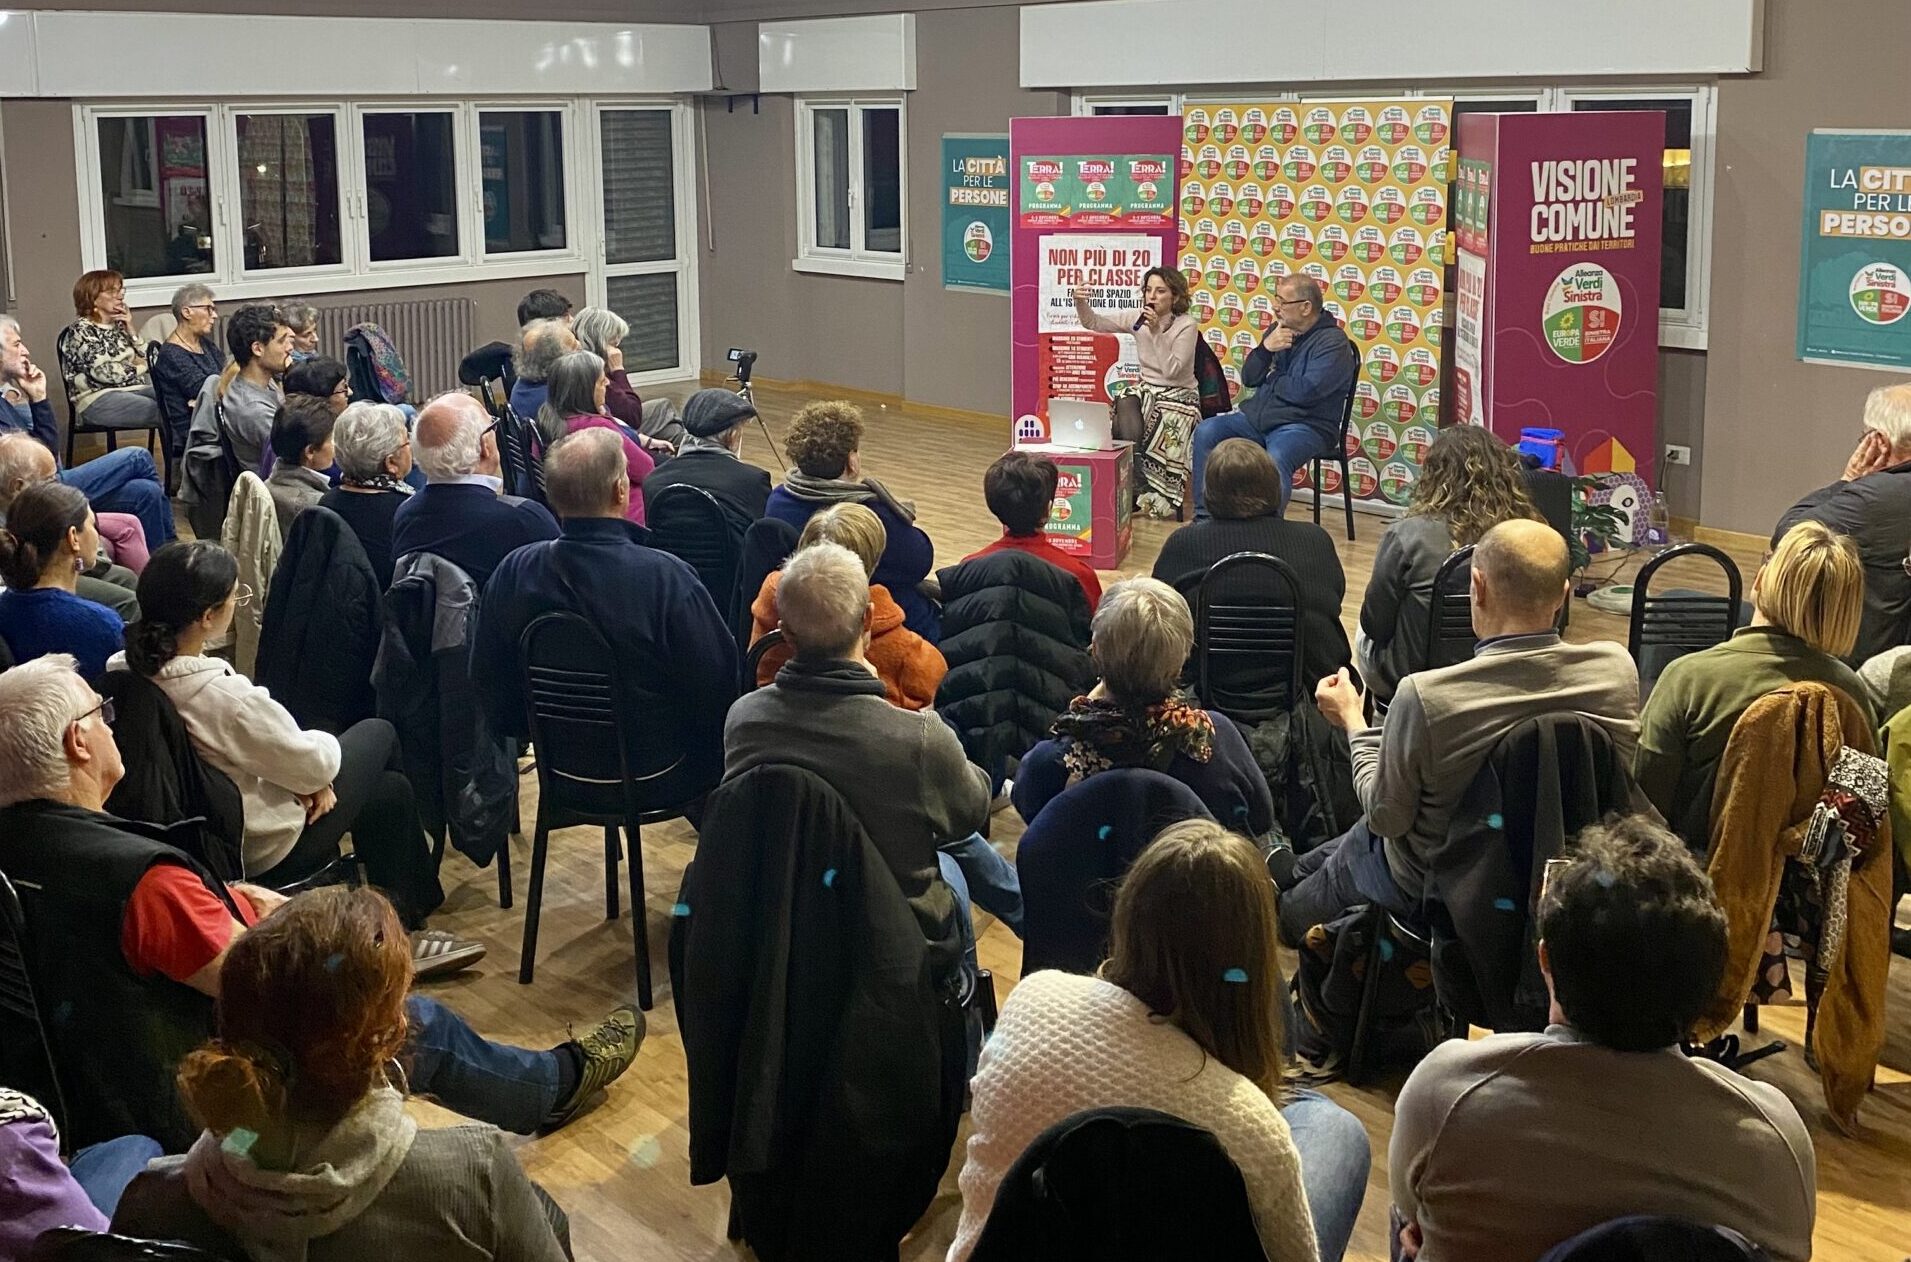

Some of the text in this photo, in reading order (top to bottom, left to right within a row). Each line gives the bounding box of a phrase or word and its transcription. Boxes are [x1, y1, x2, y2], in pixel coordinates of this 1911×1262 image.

[952, 154, 1005, 174] LA CITTÀ
[963, 175, 993, 188] PER LE
[1531, 158, 1637, 202] VISIONE
[1830, 169, 1911, 190] LA CIT
[951, 190, 1007, 205] PERSONE
[1854, 192, 1891, 211] PER
[1530, 201, 1636, 242] COMUNE
[1530, 239, 1635, 254] BUONE PRATICHE DAI TERRITORI
[1048, 245, 1150, 268] NON PIÙ DI 20
[1057, 268, 1141, 287] PER CLASSE
[1575, 277, 1603, 290] Verdi
[1106, 289, 1131, 299] SPAZIO
[1563, 290, 1602, 303] Sinistra
[1108, 299, 1116, 308] DI
[1118, 299, 1143, 310] QUALIT
[1588, 309, 1606, 329] SI
[1553, 337, 1580, 348] VERDE
